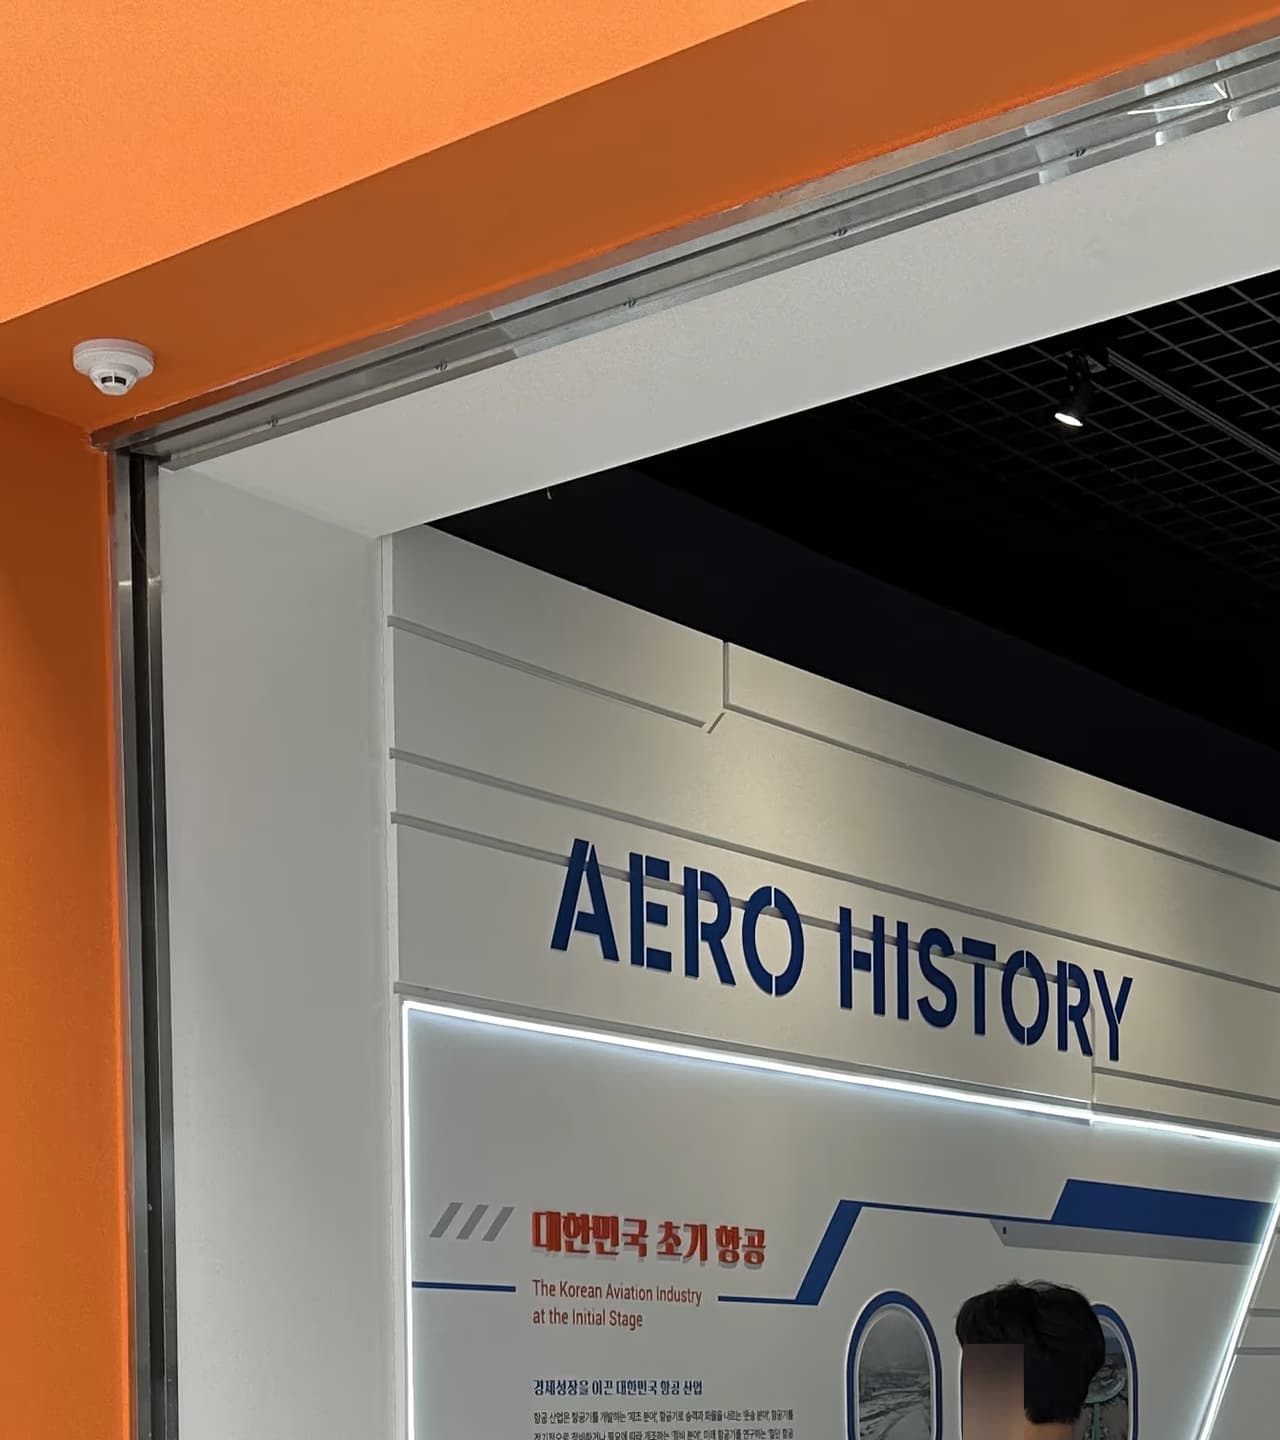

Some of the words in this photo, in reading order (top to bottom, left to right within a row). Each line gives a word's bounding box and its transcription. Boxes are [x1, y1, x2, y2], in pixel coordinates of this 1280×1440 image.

[550, 838, 805, 998] AERO
[838, 905, 1134, 1063] HISTORY
[532, 1211, 648, 1258] 대한민국
[656, 1221, 708, 1262] 초기
[715, 1225, 766, 1265] 항공
[532, 1279, 556, 1297] The
[560, 1280, 602, 1299] Korean
[606, 1283, 653, 1302] Aviation
[656, 1286, 702, 1307] Industry
[533, 1310, 545, 1325] at
[549, 1308, 569, 1325] the
[572, 1308, 605, 1326] Initial
[609, 1310, 643, 1331] Stage
[534, 1380, 589, 1395] 경제성장을
[591, 1380, 613, 1395] 이끈
[615, 1380, 658, 1395] 대한민국
[660, 1380, 680, 1395] 항공
[683, 1380, 703, 1395] 산업
